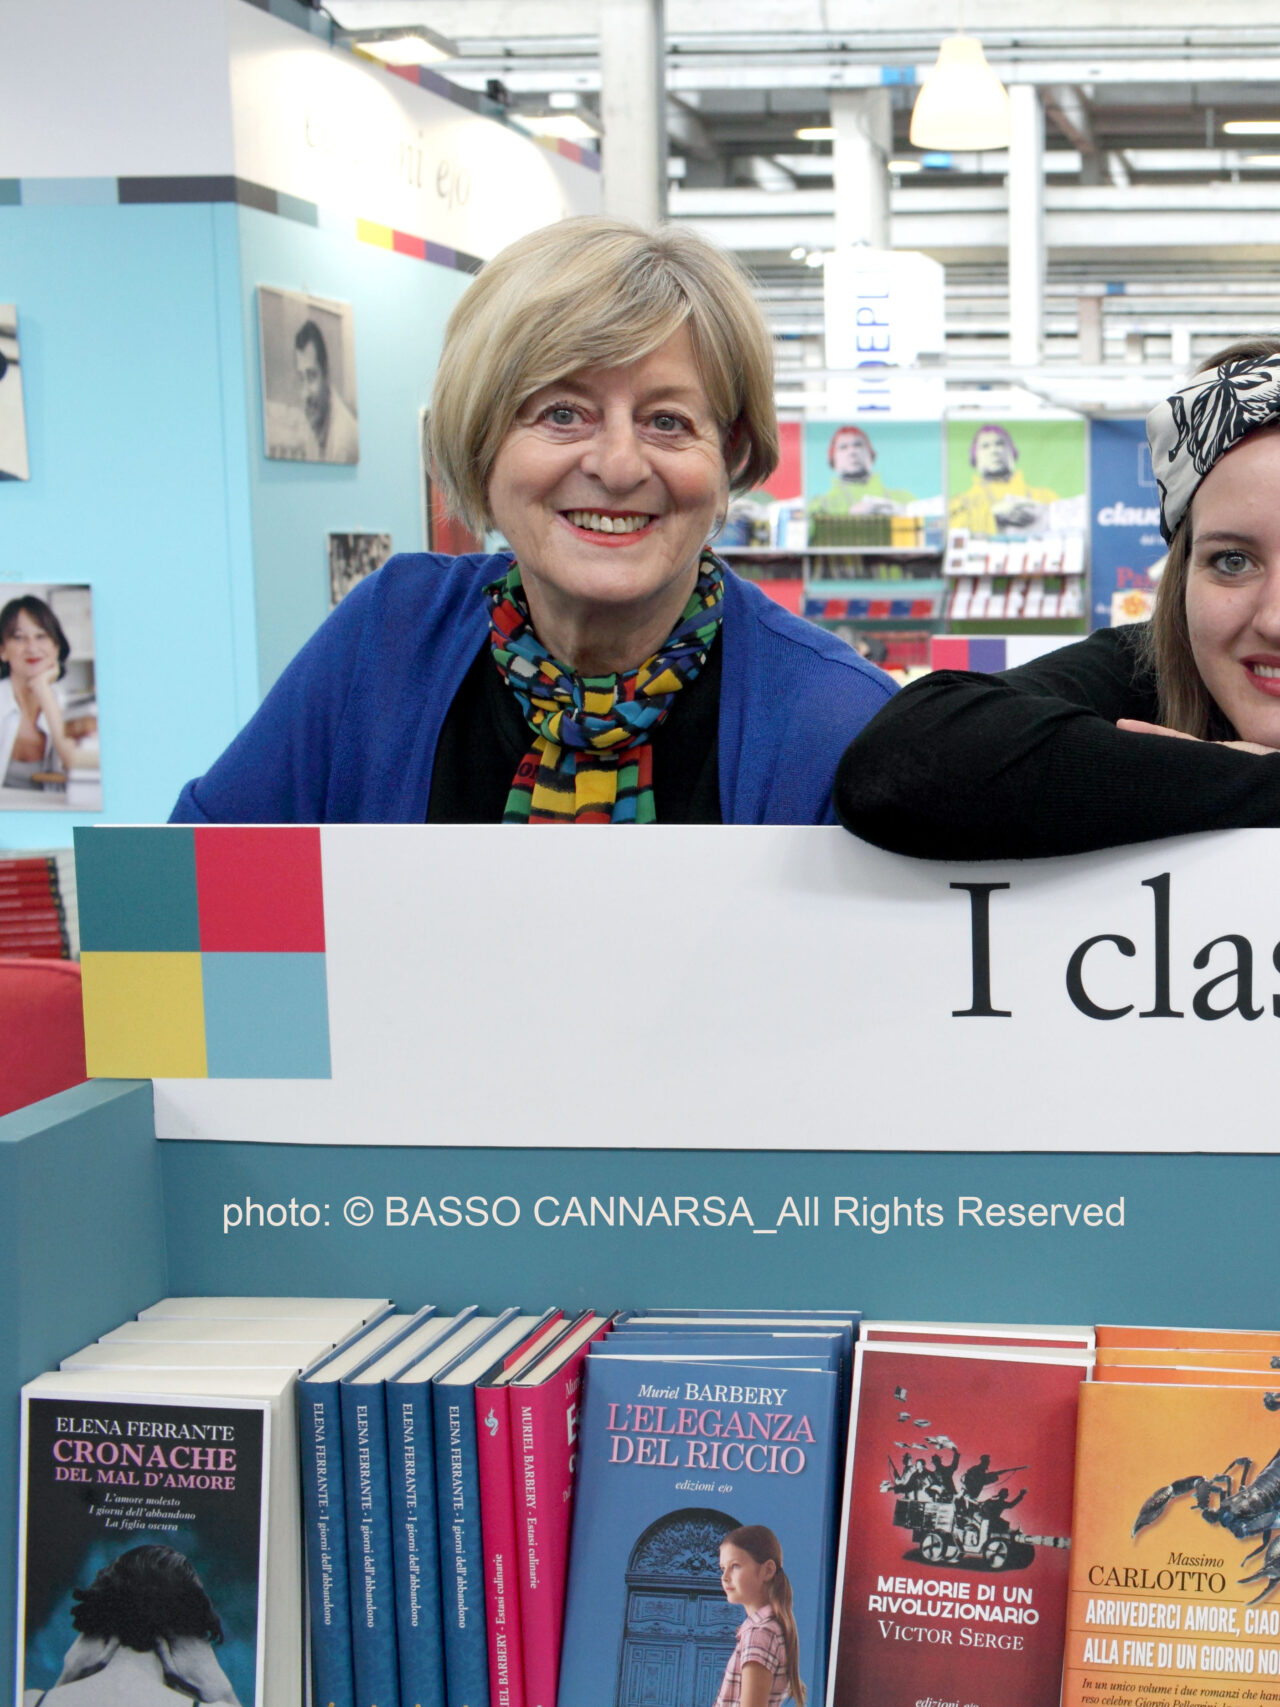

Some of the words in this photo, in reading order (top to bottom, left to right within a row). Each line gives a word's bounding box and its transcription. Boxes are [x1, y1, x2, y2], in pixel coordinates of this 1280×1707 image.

[949, 882, 1012, 1018] I
[638, 1384, 679, 1400] Muriel
[684, 1382, 788, 1406] BARBERY
[56, 1416, 122, 1436] ELENA
[126, 1421, 235, 1442] FERRANTE
[313, 1402, 326, 1442] ELENA
[356, 1405, 369, 1445] ELENA
[402, 1403, 414, 1443] ELENA
[449, 1405, 461, 1445] ELENA
[521, 1406, 534, 1453] MURIEL
[605, 1402, 816, 1444] L'ELEGANZA
[52, 1439, 237, 1472] CRONACHE
[608, 1435, 679, 1467] DEL
[684, 1440, 806, 1475] RICCIO
[55, 1466, 92, 1483] DEL
[96, 1469, 140, 1486] MAL
[144, 1472, 236, 1491] D'AMORE
[315, 1445, 329, 1508] FERRANTE
[359, 1447, 372, 1510] FERRANTE
[404, 1445, 417, 1508] FERRANTE
[450, 1448, 464, 1511] FERRANTE
[524, 1455, 537, 1509] BARBERY
[675, 1479, 715, 1493] edizioni
[88, 1505, 95, 1514] I
[96, 1506, 124, 1517] giorni
[126, 1507, 196, 1521] dell'abbandono
[104, 1492, 144, 1505] L'amore
[145, 1495, 181, 1506] molesto
[105, 1517, 118, 1528] La
[119, 1518, 145, 1531] figlia
[147, 1522, 179, 1532] oscura
[317, 1522, 331, 1551] giorni
[360, 1525, 374, 1553] giorni
[405, 1523, 419, 1552] giorni
[452, 1525, 466, 1554] giorni
[526, 1517, 538, 1546] Estasi
[493, 1553, 504, 1594] culinarie
[528, 1548, 540, 1589] culinarie
[1167, 1552, 1224, 1569] Massimo
[877, 1575, 970, 1600] MEMORIE
[977, 1583, 995, 1602] DI
[1003, 1586, 1033, 1605] UN
[1088, 1565, 1226, 1594] CARLOTTO
[494, 1596, 506, 1625] Estasi
[868, 1594, 1040, 1625] RIVOLUZIONARIO
[1085, 1598, 1180, 1630] ARRIVEDERCI
[1184, 1605, 1241, 1638] AMORE,
[1244, 1608, 1280, 1636] CIAO
[496, 1632, 509, 1685] BARBERY
[1083, 1637, 1119, 1665] ALLA
[1122, 1641, 1154, 1668] FINE
[1157, 1643, 1173, 1669] DI
[1176, 1644, 1197, 1670] UN
[1200, 1645, 1255, 1674] GIORNO
[1081, 1695, 1099, 1704] reso
[1101, 1696, 1133, 1706] celebre
[1082, 1678, 1092, 1689] In
[1095, 1681, 1107, 1690] un
[1110, 1681, 1136, 1692] unico
[1138, 1683, 1173, 1695] volume
[1174, 1684, 1180, 1695] i
[1180, 1685, 1198, 1697] due
[1200, 1688, 1241, 1699] romanzi
[1241, 1689, 1258, 1700] che
